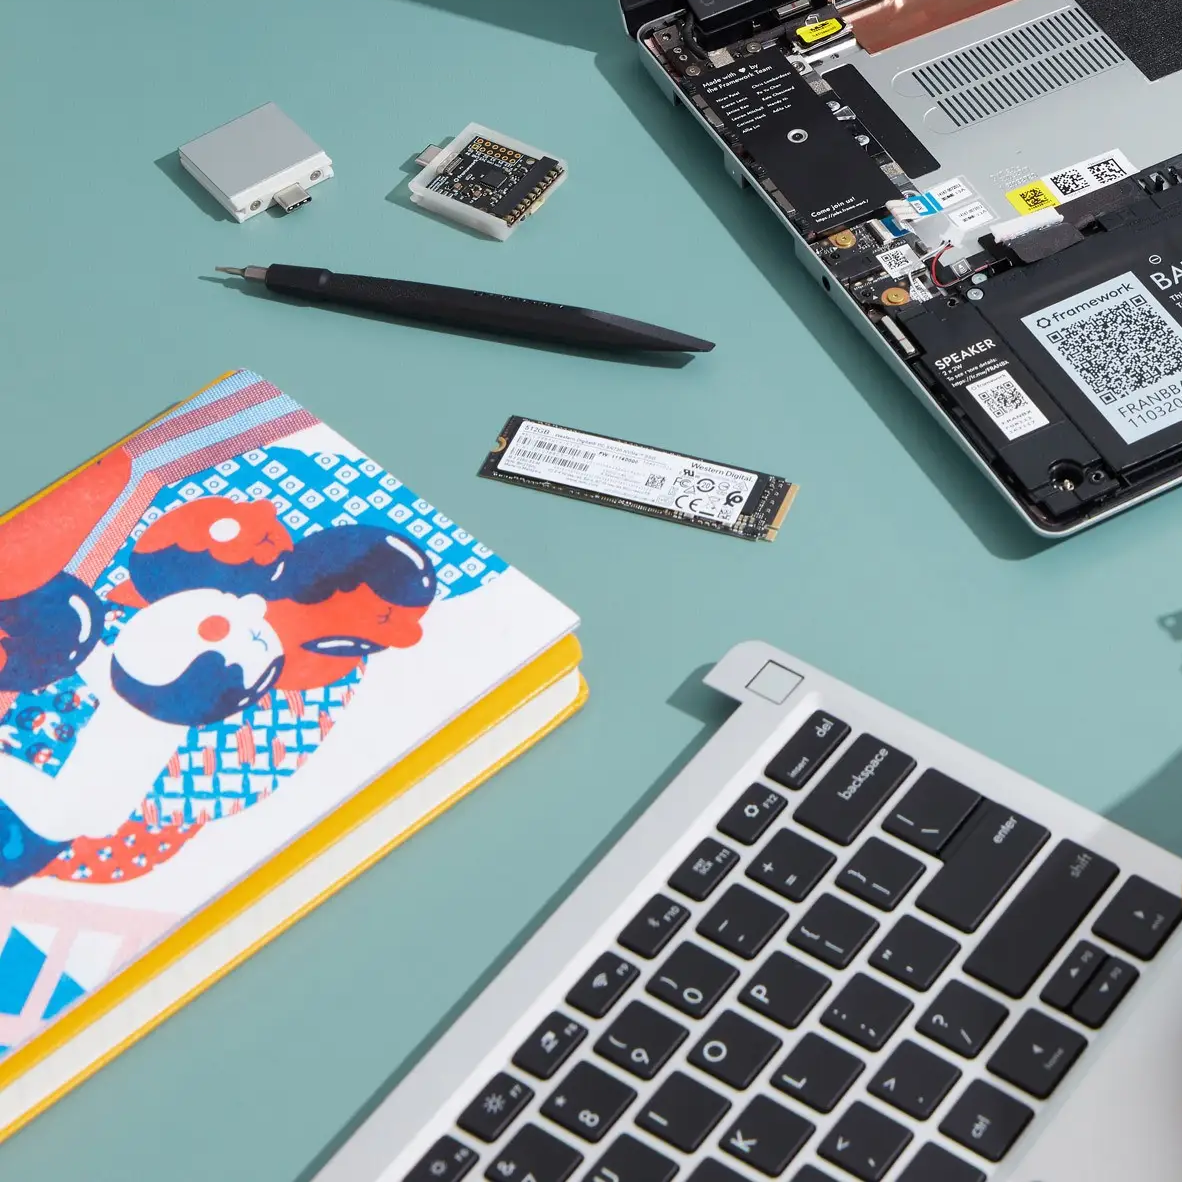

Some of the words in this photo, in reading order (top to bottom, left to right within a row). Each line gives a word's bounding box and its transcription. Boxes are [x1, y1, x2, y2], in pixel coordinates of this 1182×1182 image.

[718, 72, 755, 89] Framework
[754, 65, 773, 75] Team
[722, 72, 737, 80] with
[810, 207, 831, 218] Come
[830, 201, 845, 210] join
[845, 196, 856, 204] us!
[1051, 283, 1134, 322] framework
[934, 338, 996, 370] SPEAKER
[524, 424, 550, 435] 512GB
[691, 461, 724, 476] Western
[815, 717, 834, 738] del
[836, 745, 890, 802] backspace
[762, 792, 780, 809] F12
[992, 815, 1018, 844] enter
[1069, 851, 1093, 878] shift
[750, 984, 770, 1004] P
[630, 1048, 650, 1065] 9
[702, 1040, 728, 1063] O
[782, 1074, 807, 1089] L
[578, 1109, 600, 1128] 8
[971, 1114, 990, 1138] ctrl
[730, 1130, 757, 1153] K
